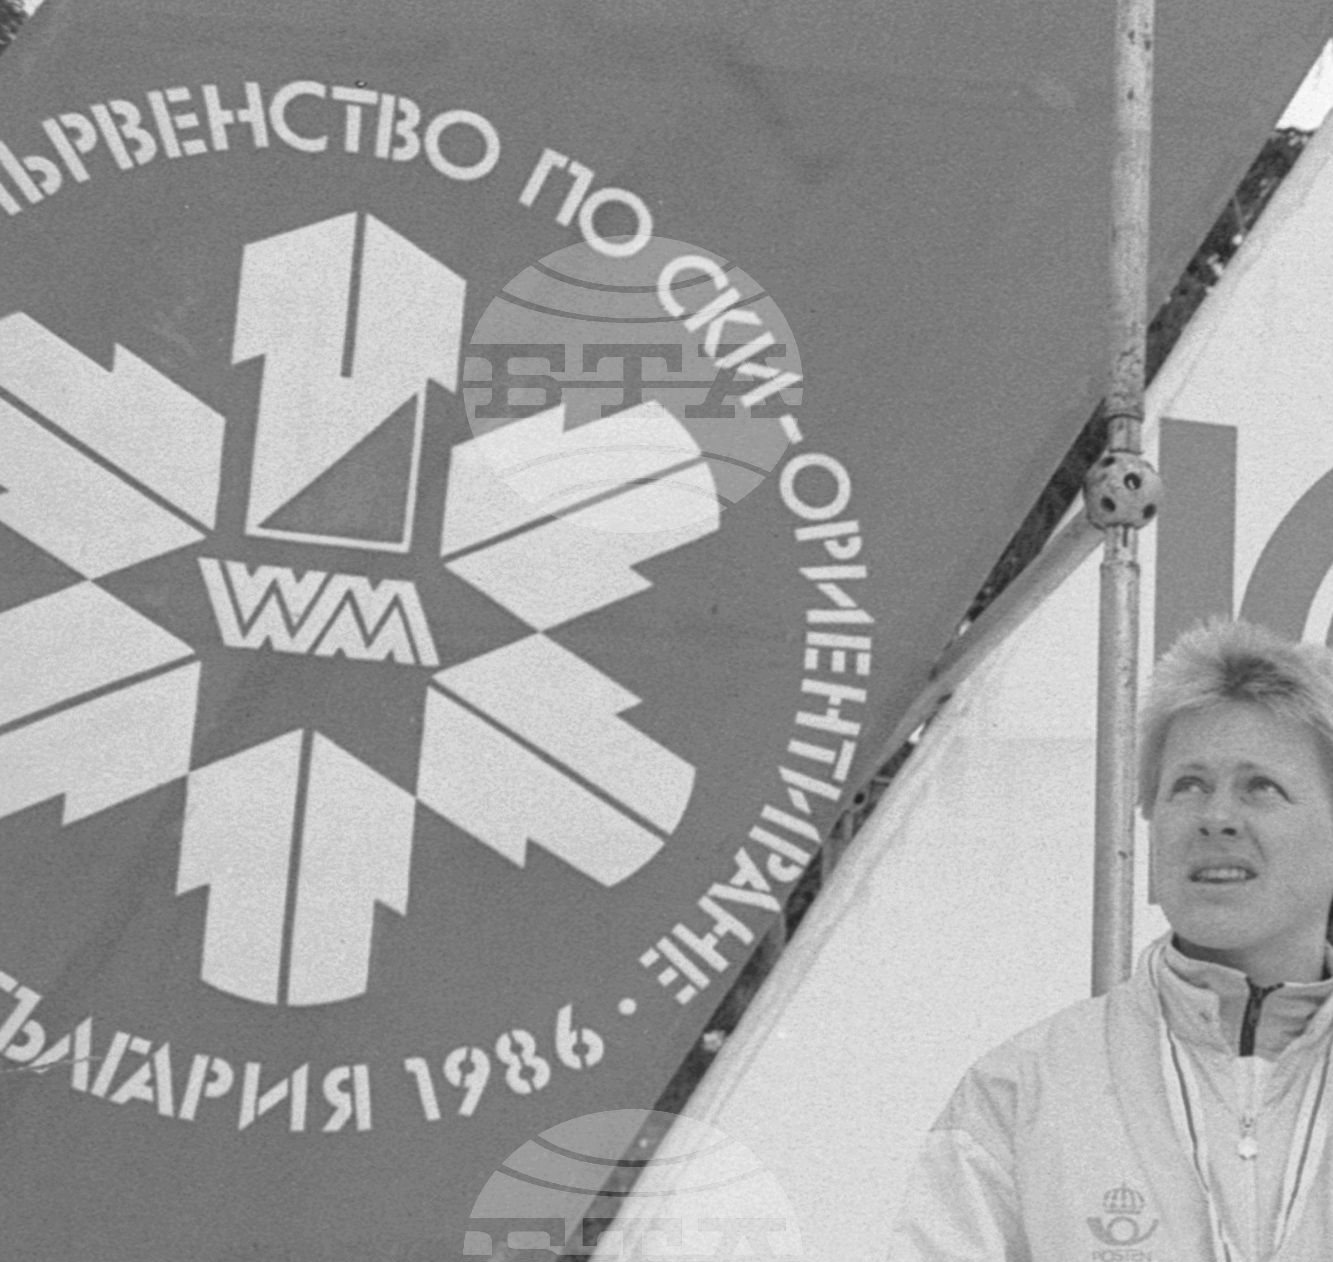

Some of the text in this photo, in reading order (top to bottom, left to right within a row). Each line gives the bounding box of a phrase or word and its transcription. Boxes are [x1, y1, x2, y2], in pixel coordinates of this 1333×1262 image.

[0, 79, 501, 216] ЪРВЕНСТВО
[519, 147, 653, 258] ПО
[0, 970, 605, 1132] ЪЛГАРИЯ 1986
[1092, 1250, 1153, 1262] POSTEN
